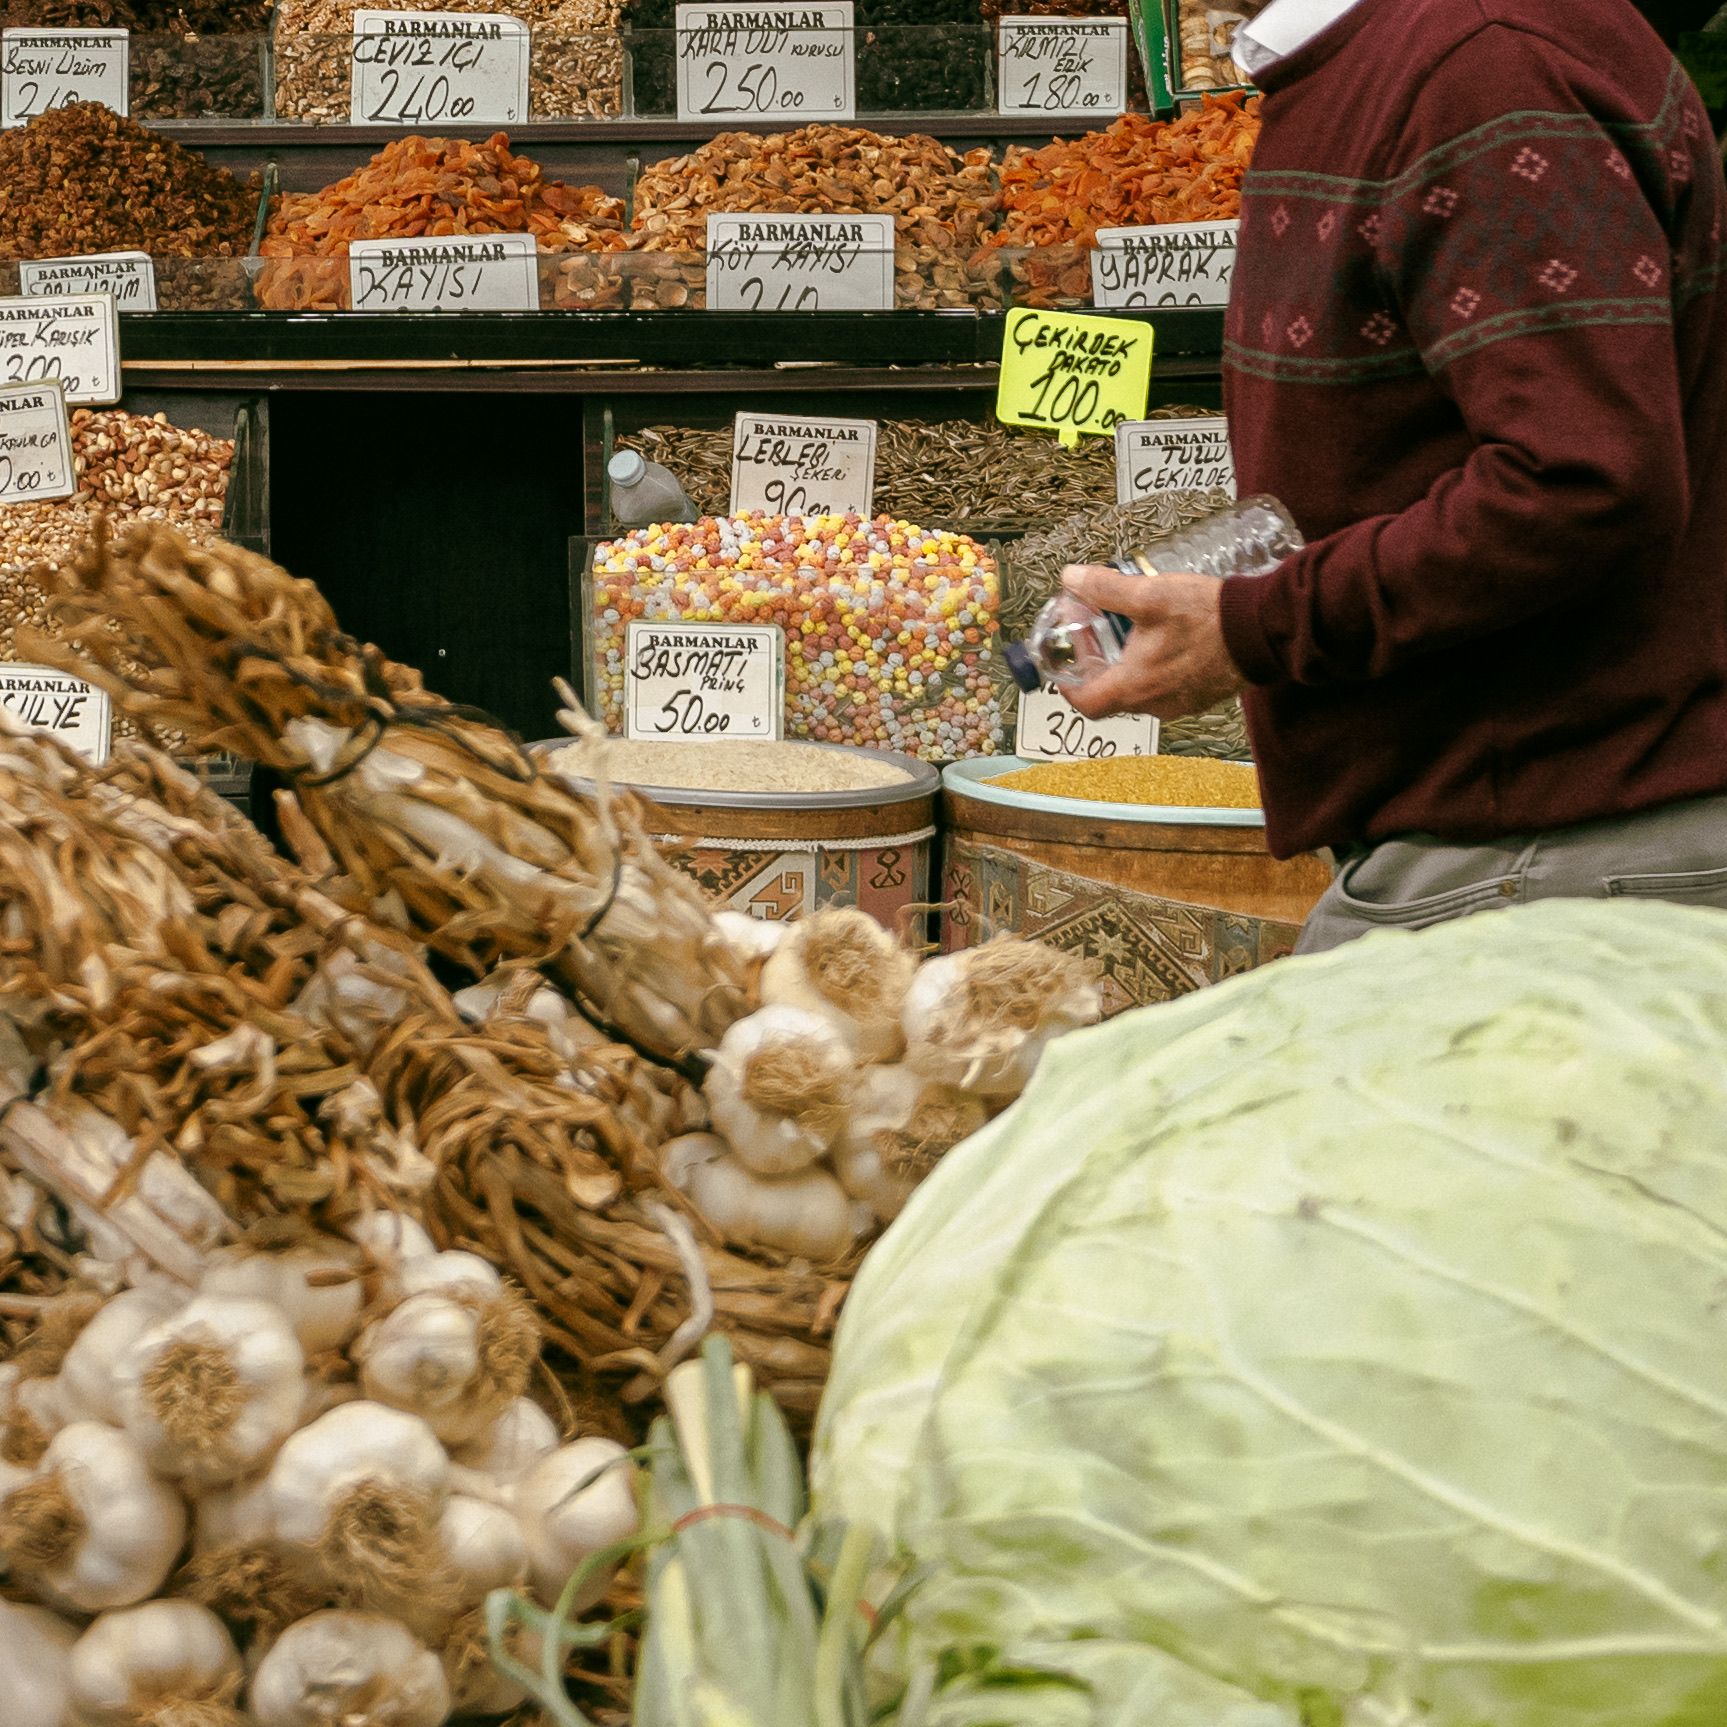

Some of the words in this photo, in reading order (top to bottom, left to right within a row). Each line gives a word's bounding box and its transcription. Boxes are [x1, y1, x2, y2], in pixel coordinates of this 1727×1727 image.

[385, 21, 502, 40] BARMANLAR
[706, 12, 825, 29] BARMANLAR
[1016, 25, 1110, 37] BARMANLAR
[19, 37, 112, 49] BARMANLAR
[680, 27, 737, 60] KARA
[700, 61, 804, 114] 250.00
[1019, 72, 1100, 110] 180.00
[739, 224, 864, 242] BARMANLAR
[382, 243, 507, 267] BARMANLAR
[38, 262, 136, 281] BARMANLAR
[1100, 248, 1217, 290] YAPRAK
[356, 265, 483, 304] KAYISI
[1013, 313, 1138, 358] ÇEKİRDEK
[754, 424, 859, 441] BARMANLAR
[649, 635, 758, 650] BARMANLAR
[654, 689, 730, 734] 50.00
[1039, 711, 1117, 759] 30.00
